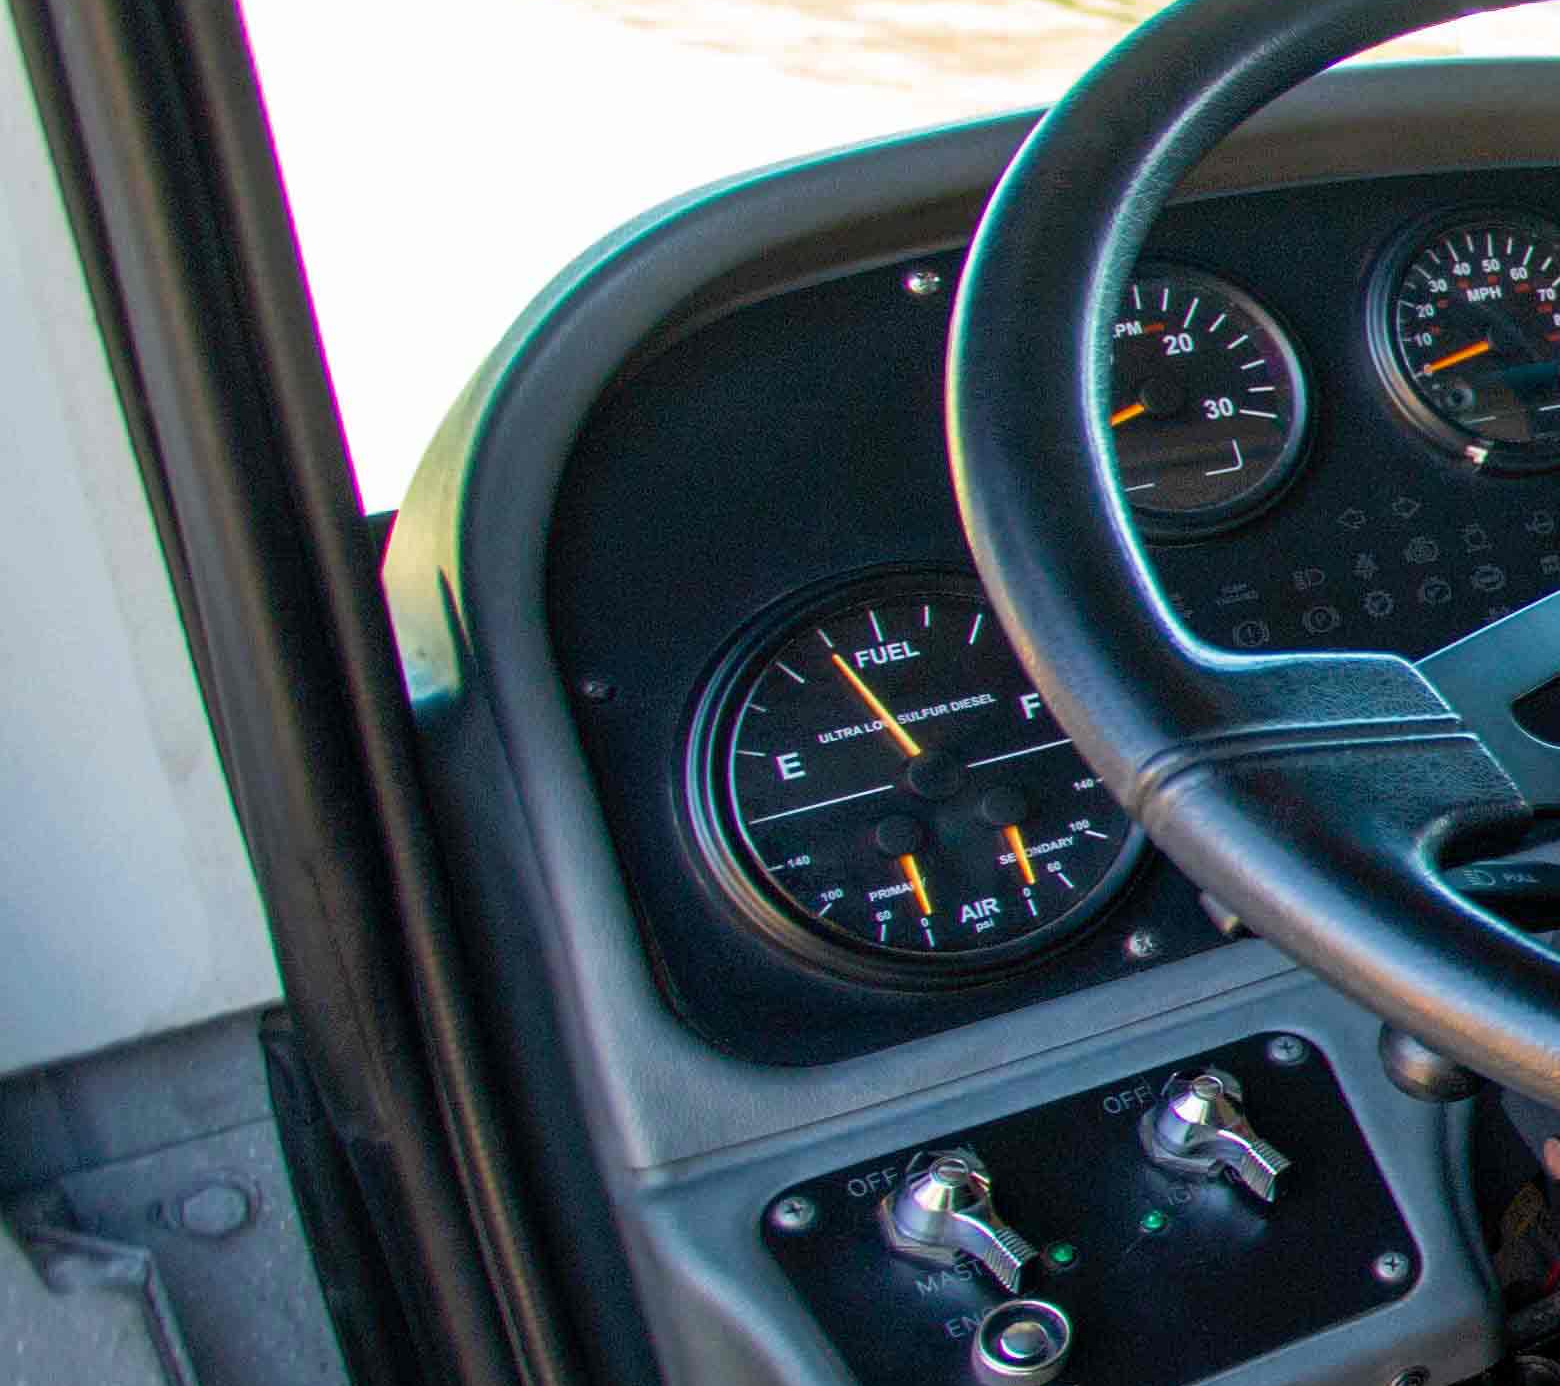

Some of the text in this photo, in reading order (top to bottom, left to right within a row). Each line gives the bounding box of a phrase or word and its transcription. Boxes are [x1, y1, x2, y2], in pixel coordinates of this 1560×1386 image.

[1453, 263, 1471, 276] 40
[1482, 259, 1500, 272] 50
[1510, 267, 1528, 280] 60
[1429, 279, 1447, 293] 30
[1467, 286, 1502, 302] MPH
[1537, 288, 1556, 301] 70
[1416, 304, 1434, 318] 20
[1113, 321, 1142, 338] PM
[1163, 333, 1194, 356] 20
[1415, 333, 1432, 346] 10
[1203, 397, 1234, 419] 30
[854, 640, 920, 669] FUEL
[1019, 692, 1042, 720] F
[818, 725, 867, 743] ULTRA
[896, 704, 949, 724] SULFUR
[951, 693, 997, 712] DIESEL
[775, 751, 806, 781] E
[1074, 778, 1094, 791] 140
[1069, 819, 1090, 832] 100
[998, 836, 1074, 865] SEONDARY
[787, 855, 811, 869] 140
[820, 888, 844, 903] 100
[1022, 887, 1031, 898] 0
[960, 897, 1000, 924] AIR
[920, 917, 929, 928] 0
[976, 918, 994, 934] psi
[1104, 1086, 1152, 1113] OFF
[848, 1167, 898, 1198] OFF
[914, 1258, 985, 1297] MAST
